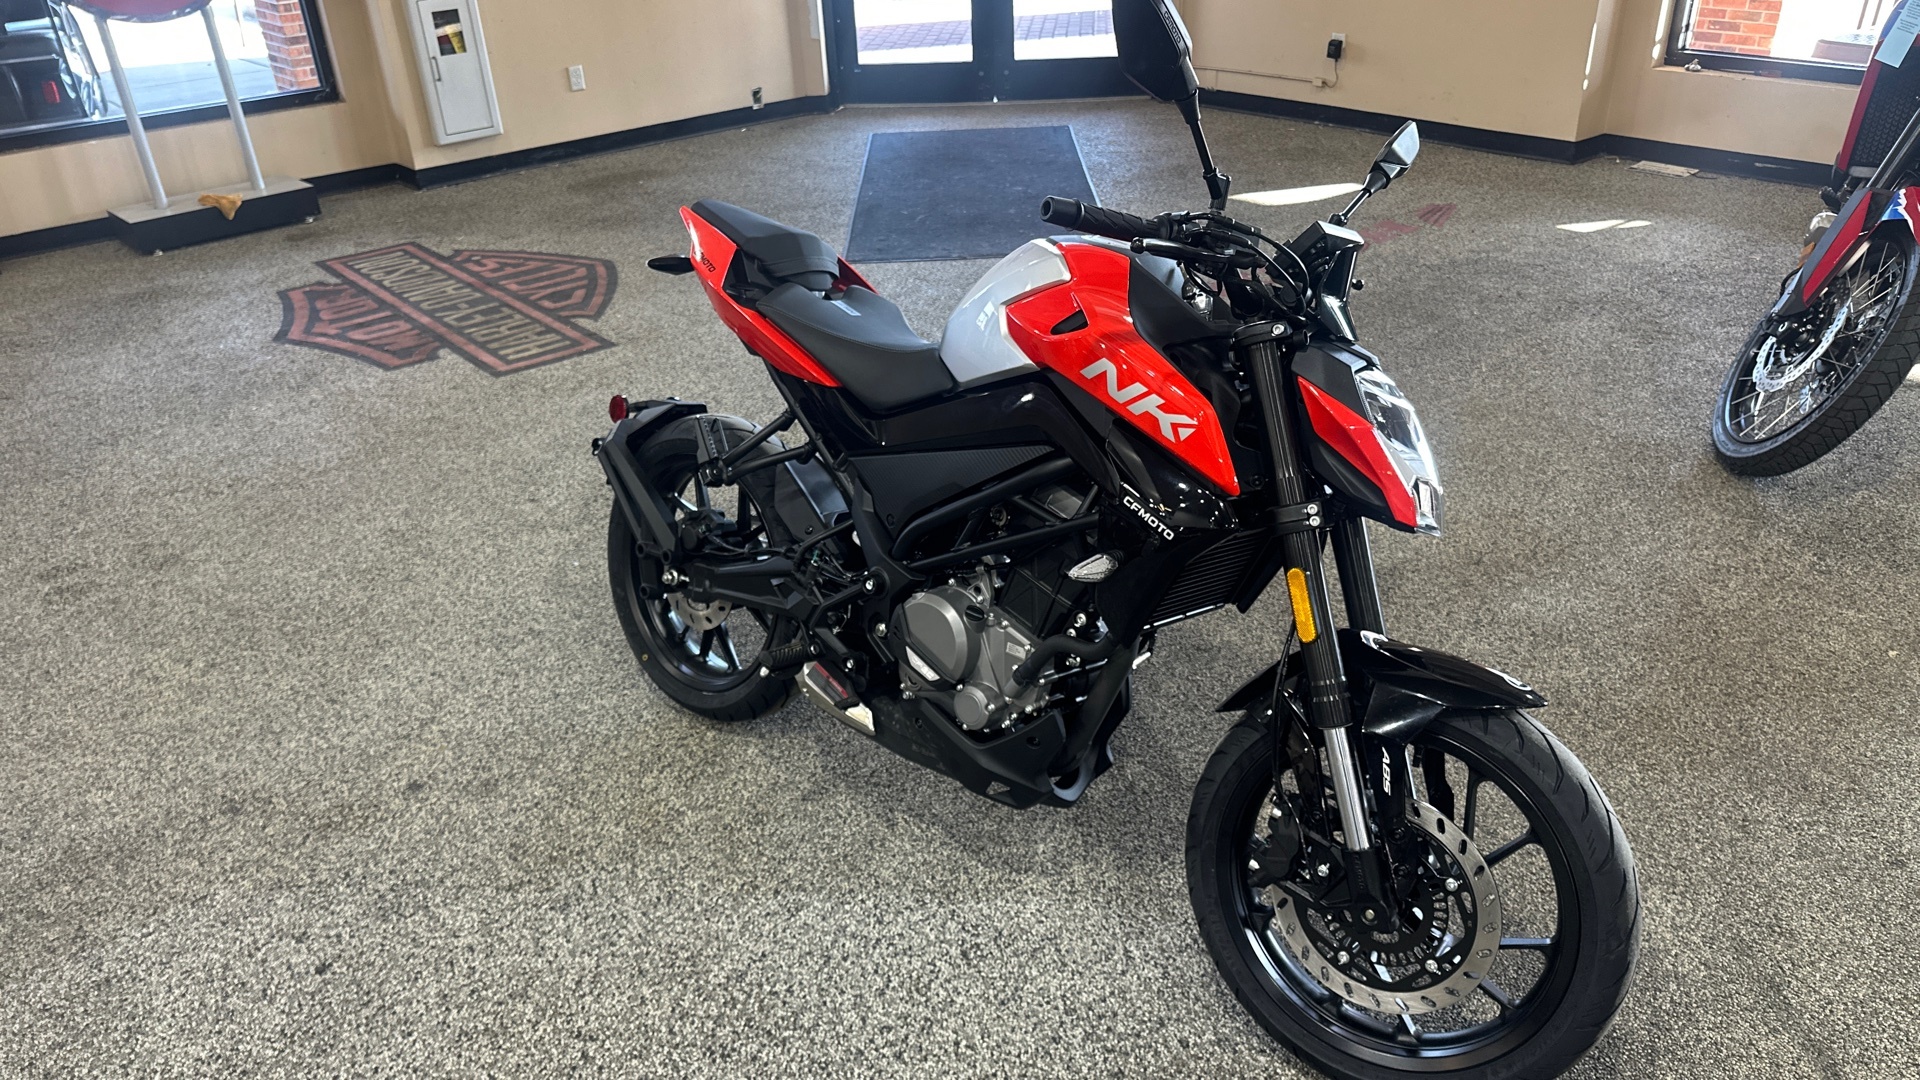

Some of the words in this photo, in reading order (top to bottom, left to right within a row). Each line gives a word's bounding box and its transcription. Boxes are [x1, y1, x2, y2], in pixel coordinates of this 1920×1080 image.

[347, 251, 573, 361] HARLEY-DAVIDSON
[463, 255, 589, 309] CYCLES
[1079, 357, 1198, 443] NK
[1123, 496, 1175, 541] CFMOTO
[1382, 746, 1391, 796] ABS
